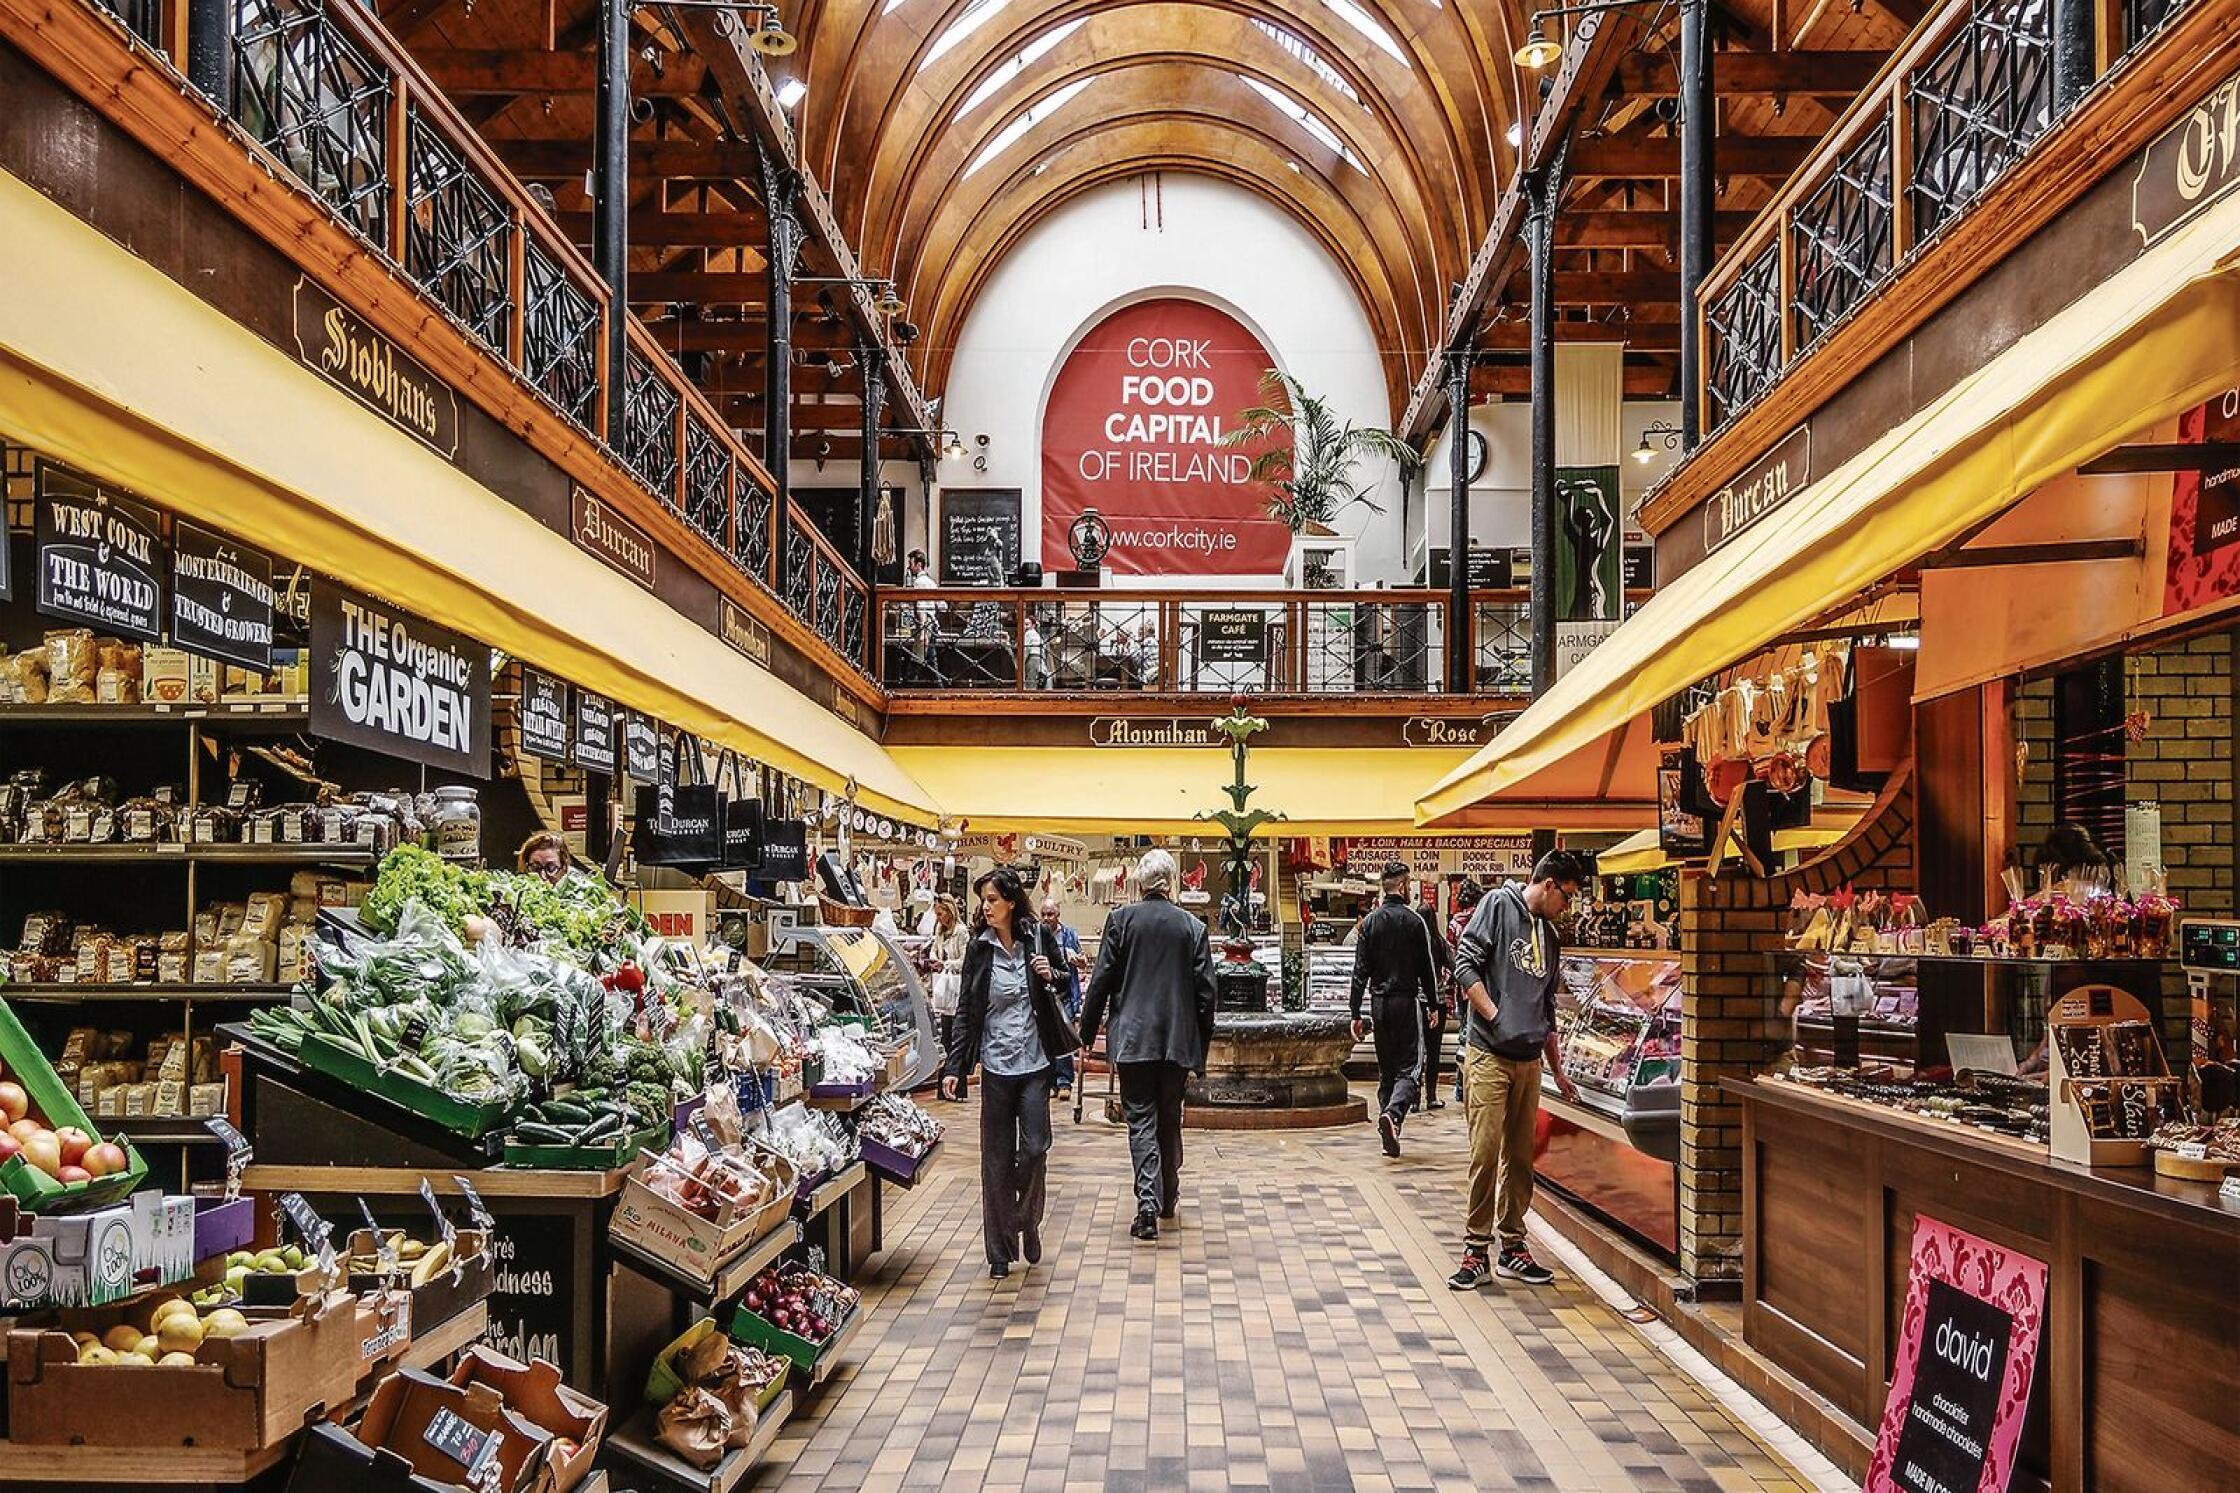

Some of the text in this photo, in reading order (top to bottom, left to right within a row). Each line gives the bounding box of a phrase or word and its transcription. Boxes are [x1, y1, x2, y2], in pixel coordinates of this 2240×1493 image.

[1127, 338, 1211, 369] CORK
[322, 306, 436, 437] Siobhan's
[1122, 376, 1214, 405] FOOD
[1105, 413, 1226, 444] CAPITAL
[1079, 450, 1252, 484] OF IRELAND
[1720, 459, 1789, 538] Durcan
[51, 502, 152, 565] WEST CORK
[581, 497, 650, 575] Durcan
[2211, 516, 2238, 539] MADE
[97, 541, 110, 564] &
[50, 553, 91, 592] THE
[94, 567, 154, 610] WORLD
[174, 550, 206, 580] MOST
[206, 558, 274, 608] EXPERIENCED
[222, 591, 232, 613] &
[174, 593, 223, 636] TRUSTED
[225, 618, 273, 645] GROWERS
[1209, 613, 1259, 623] FARMGATE
[341, 599, 389, 660] THE
[391, 621, 467, 689] Organic
[341, 650, 472, 754] GARDEN
[1421, 717, 1478, 743] Rose
[671, 818, 710, 829] DURCAN
[1036, 839, 1083, 856] OULTRY
[1347, 850, 1401, 862] SAUSAGES
[1400, 838, 1423, 847] HAM
[1435, 838, 1472, 848] BACON
[1473, 837, 1533, 849] SPECIALIST
[1414, 850, 1440, 860] LOIN
[1347, 862, 1385, 873] PUDDIN
[1414, 862, 1439, 872] HAM
[1462, 863, 1488, 872] PORK
[646, 912, 694, 937] DEN
[495, 1263, 554, 1296] dness
[1935, 1316, 1994, 1382] david
[1911, 1400, 1983, 1461] handmade chocolates
[1904, 1460, 1927, 1488] MADE
[1924, 1475, 1936, 1493] IN
